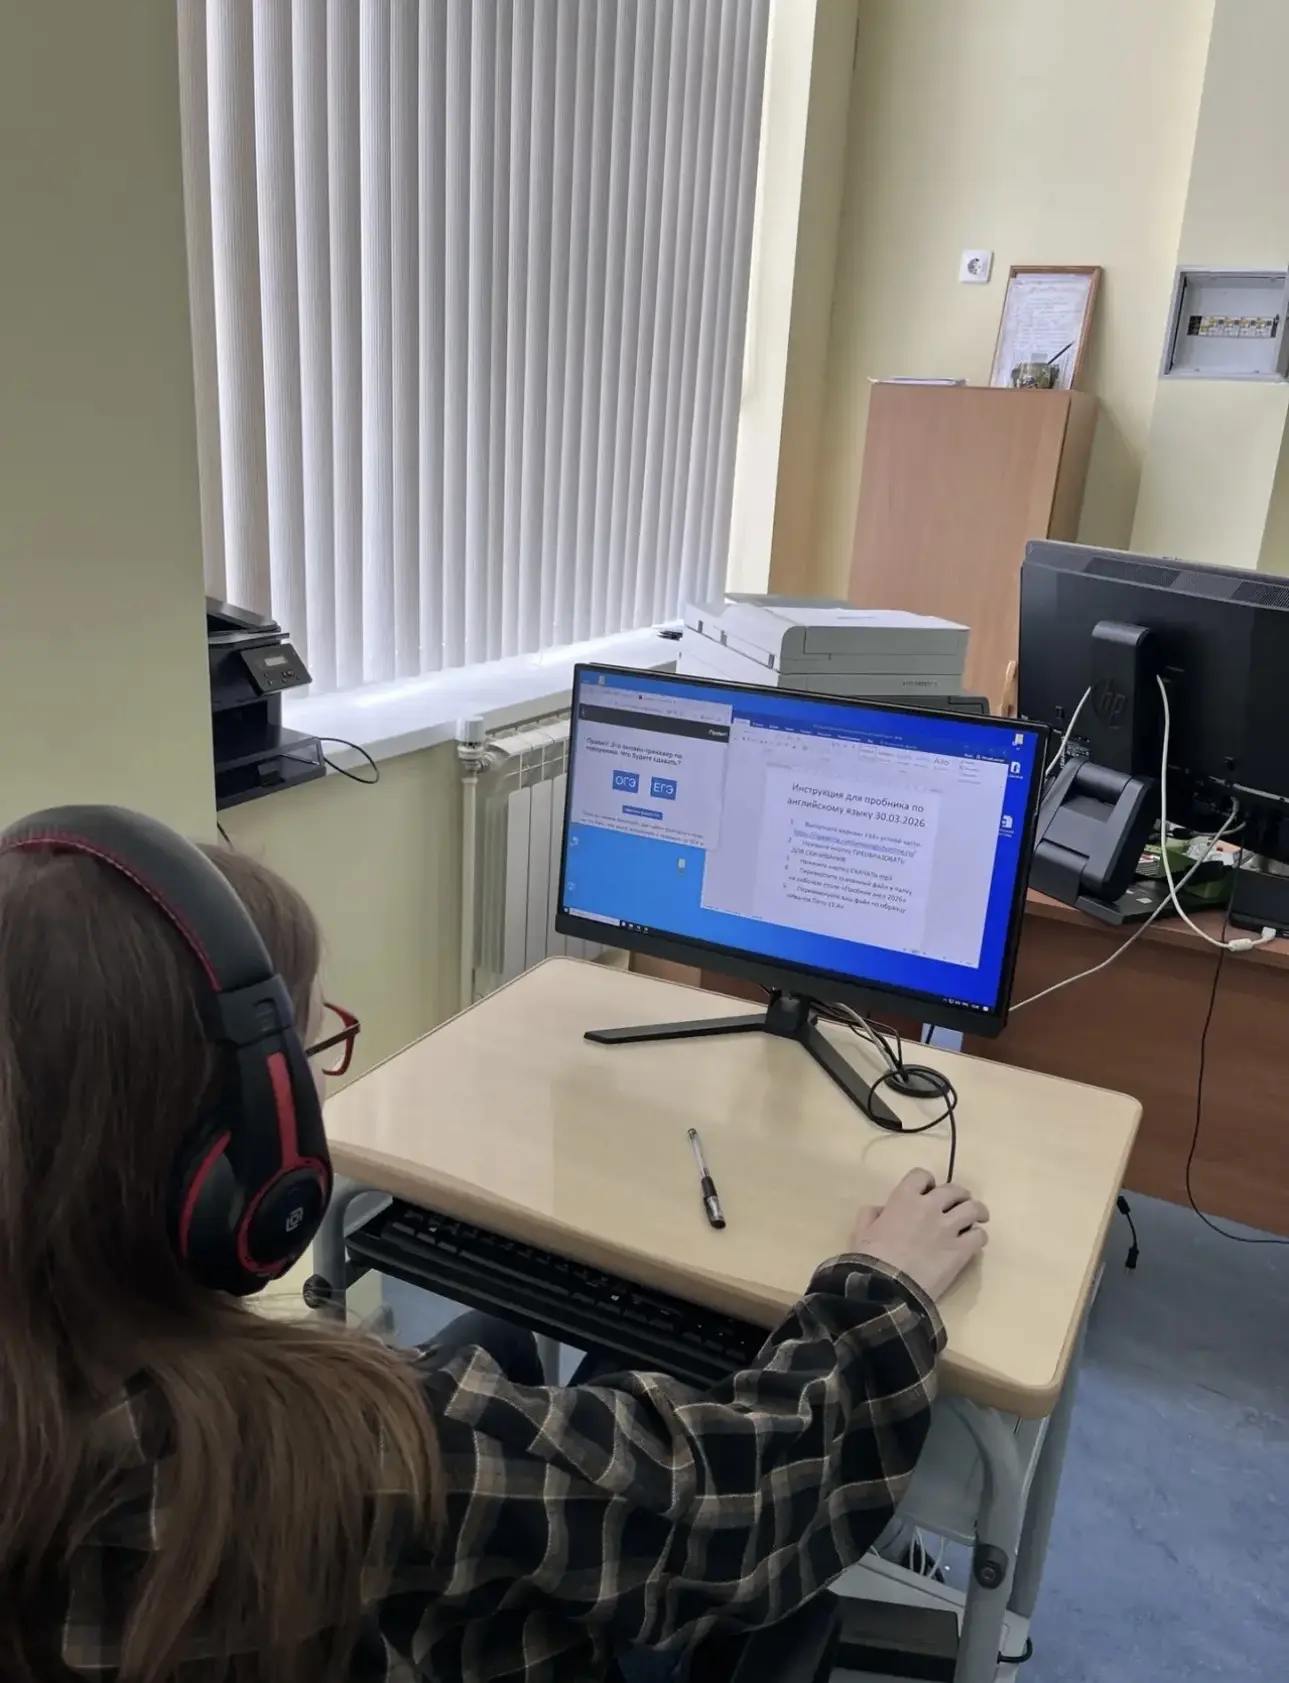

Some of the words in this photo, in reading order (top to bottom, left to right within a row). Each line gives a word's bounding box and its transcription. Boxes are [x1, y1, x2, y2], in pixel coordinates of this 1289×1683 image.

[632, 752, 651, 762] будете
[653, 757, 682, 766] сдавать?
[615, 775, 637, 788] ОГЭ
[653, 782, 674, 795] ЕГЭ
[792, 783, 843, 799] Инструкция
[845, 793, 862, 802] для
[864, 797, 910, 811] пробника
[912, 804, 924, 813] по
[787, 798, 843, 814] английскому
[846, 808, 873, 820] языку
[875, 811, 925, 828] 30.03.2026
[850, 868, 878, 879] СКАЧАТЬ
[872, 882, 889, 891] файл
[855, 897, 870, 906] файл
[880, 903, 906, 914] образцу
